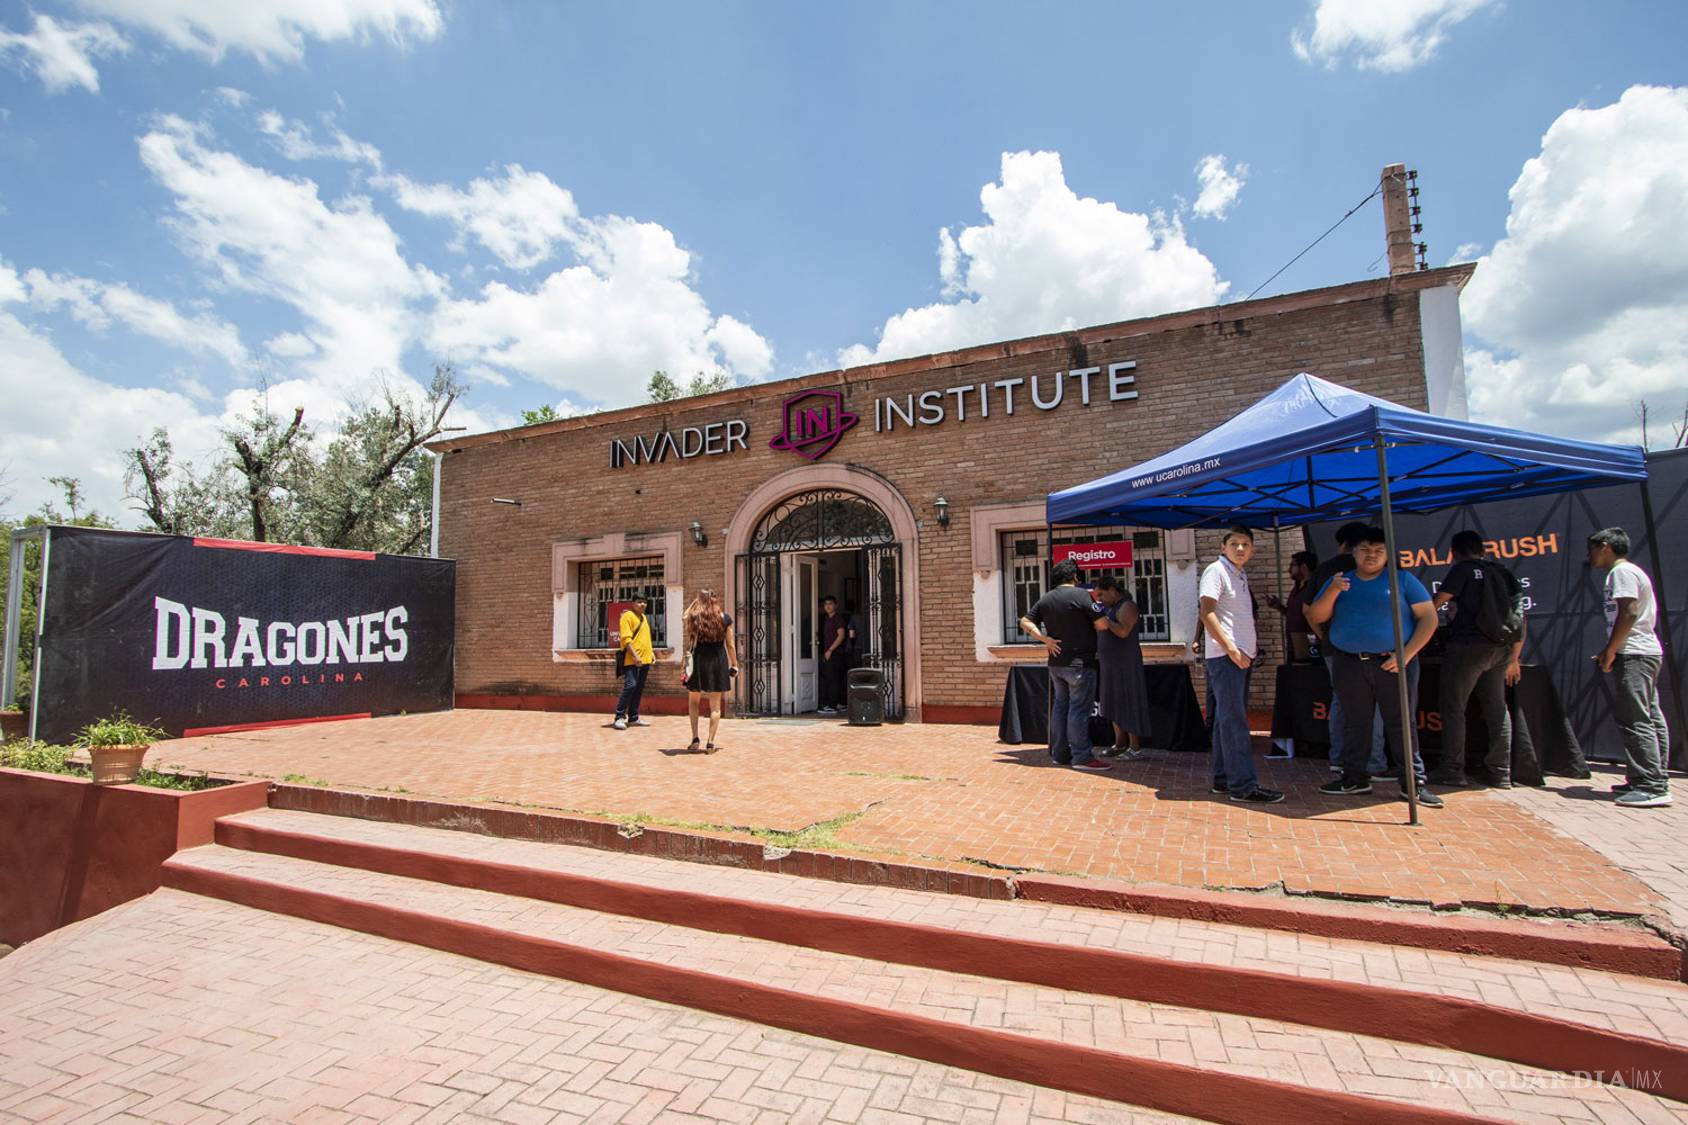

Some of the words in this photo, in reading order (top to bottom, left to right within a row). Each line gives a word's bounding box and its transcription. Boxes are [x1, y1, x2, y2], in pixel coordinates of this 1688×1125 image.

[609, 420, 748, 468] INVADER
[796, 404, 829, 437] IN
[875, 361, 1139, 432] INSTITUTE
[1068, 550, 1116, 561] Registro
[152, 595, 409, 670] DRAGONES
[215, 672, 364, 689] CAROLINA
